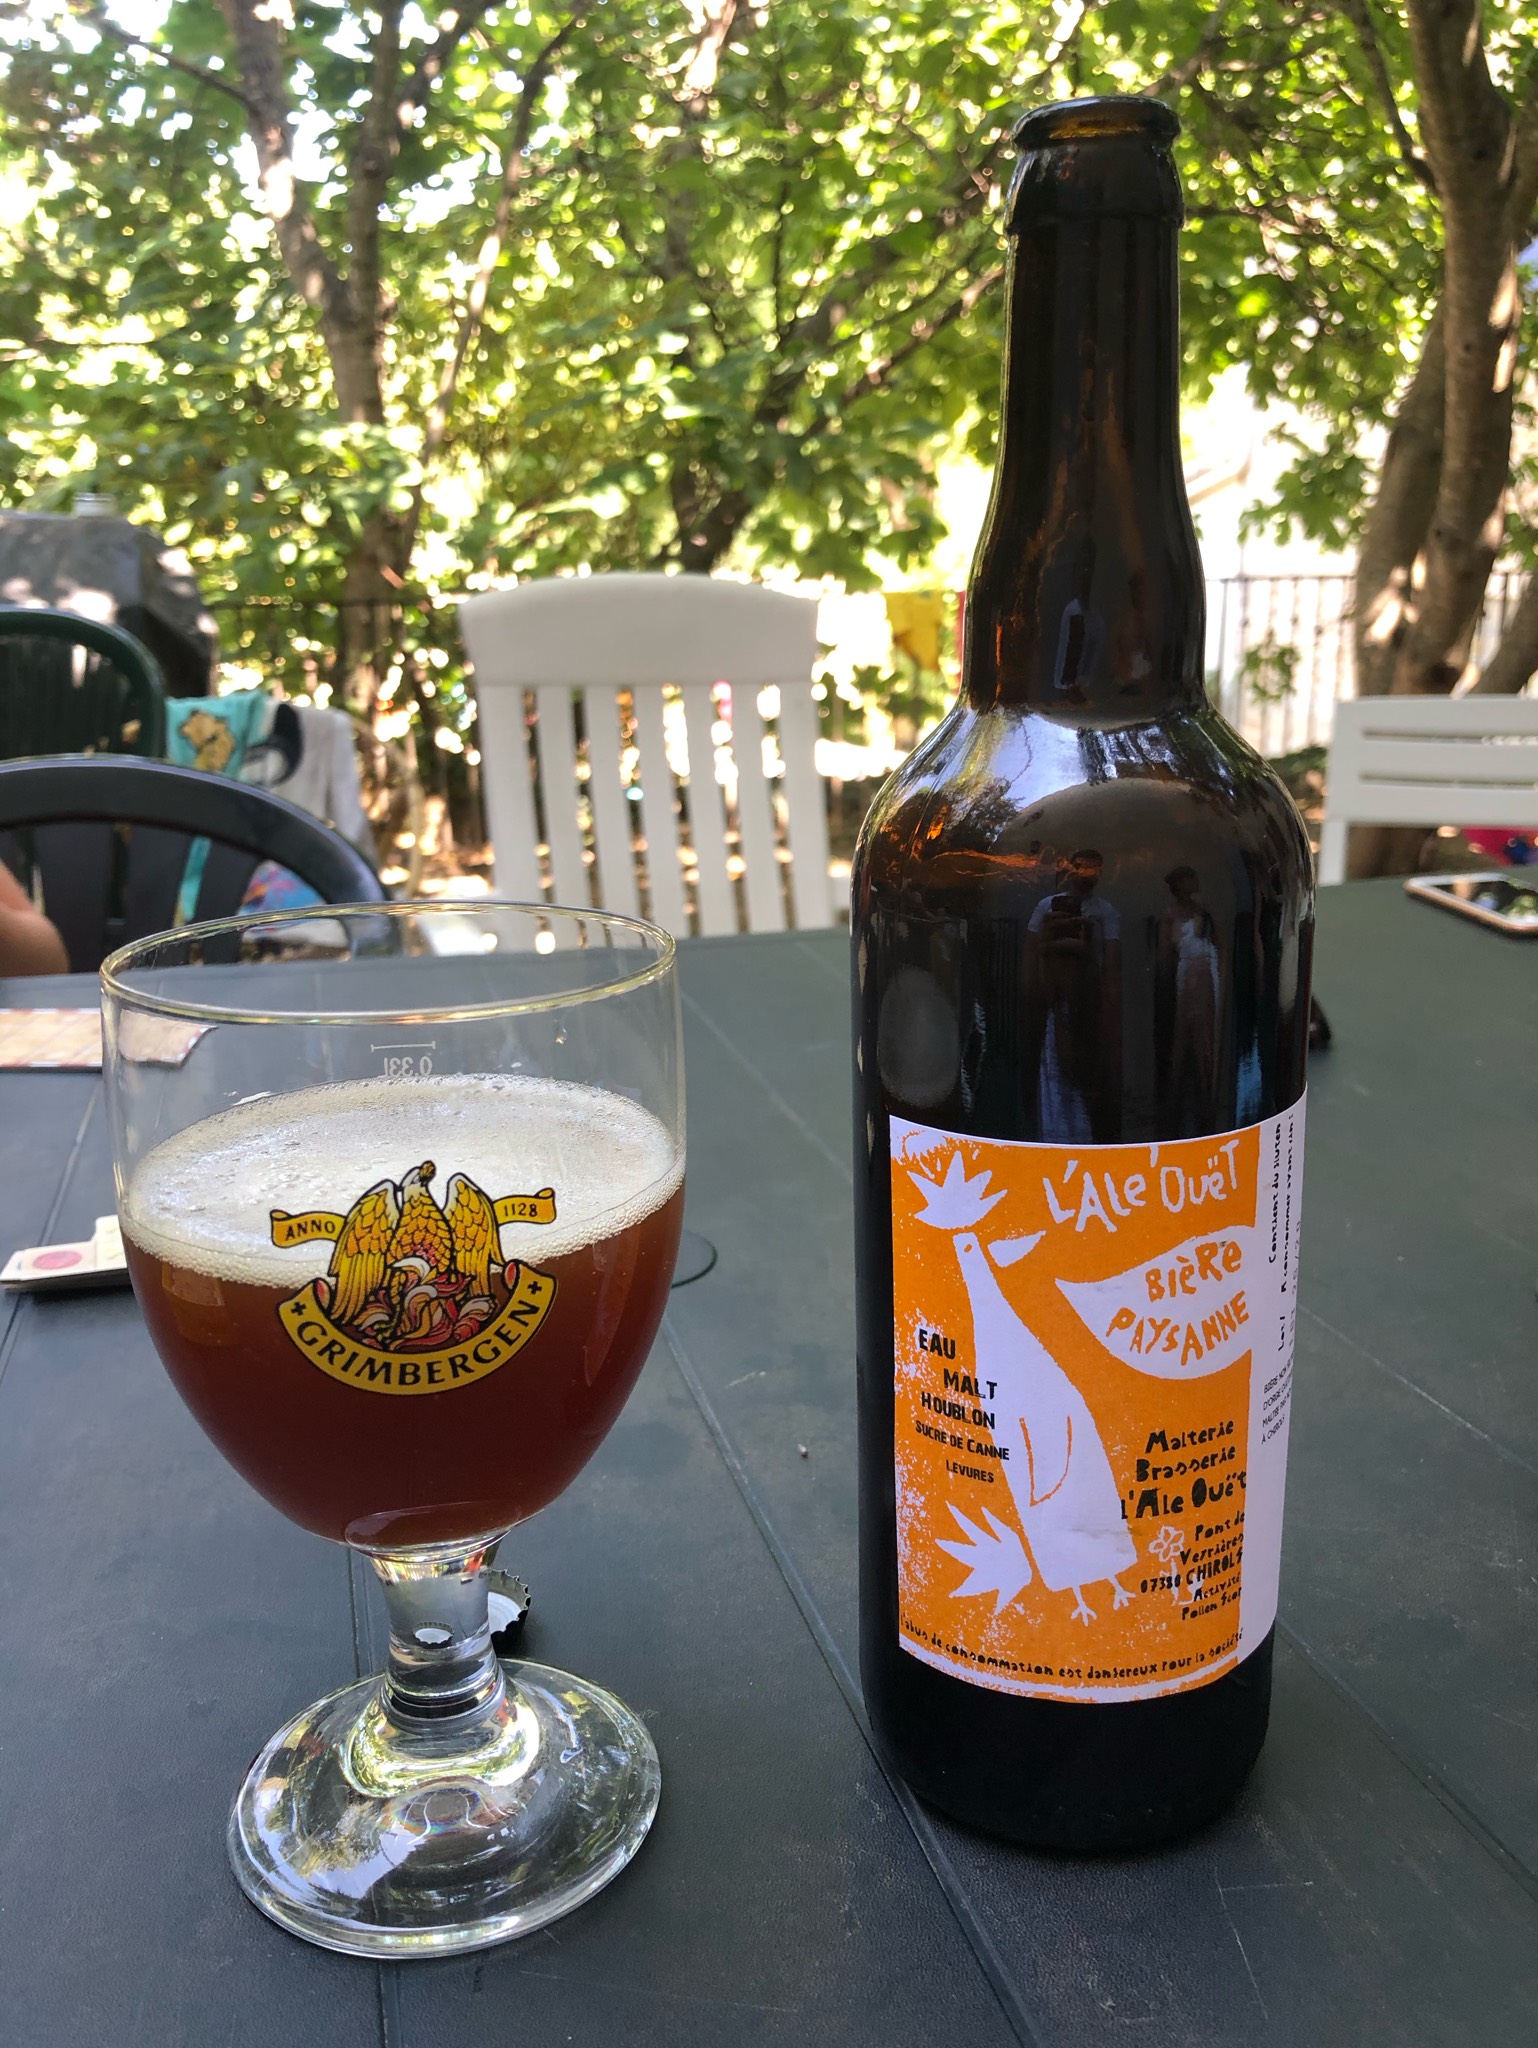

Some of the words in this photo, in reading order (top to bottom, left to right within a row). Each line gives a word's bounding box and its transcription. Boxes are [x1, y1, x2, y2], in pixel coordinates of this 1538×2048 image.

[1271, 1172, 1279, 1189] du
[503, 1203, 538, 1218] 1128
[284, 1219, 336, 1241] ANNO
[297, 1300, 542, 1386] GRIMBERGEN
[919, 1328, 956, 1360] EAU
[1106, 1290, 1249, 1366] PAYSANNE
[943, 1368, 998, 1400] MALT
[921, 1391, 996, 1430] HOUBLON
[915, 1420, 948, 1444] SUCRE
[950, 1436, 964, 1450] DE
[967, 1438, 1010, 1460] CANNE
[1145, 1421, 1234, 1454] Malterie
[946, 1460, 995, 1484] LEVURES
[1136, 1446, 1236, 1482] Brasserie
[1191, 1470, 1246, 1508] Ouët
[1195, 1519, 1231, 1541] Pont
[1234, 1510, 1245, 1526] de
[1140, 1573, 1181, 1593] 07380
[1182, 1603, 1218, 1621] Pollen
[931, 1633, 942, 1648] de
[946, 1643, 1054, 1676] consommation
[1059, 1667, 1082, 1679] est
[1087, 1662, 1157, 1679] dangereux
[1161, 1656, 1192, 1672] pour
[1195, 1653, 1206, 1664] la
